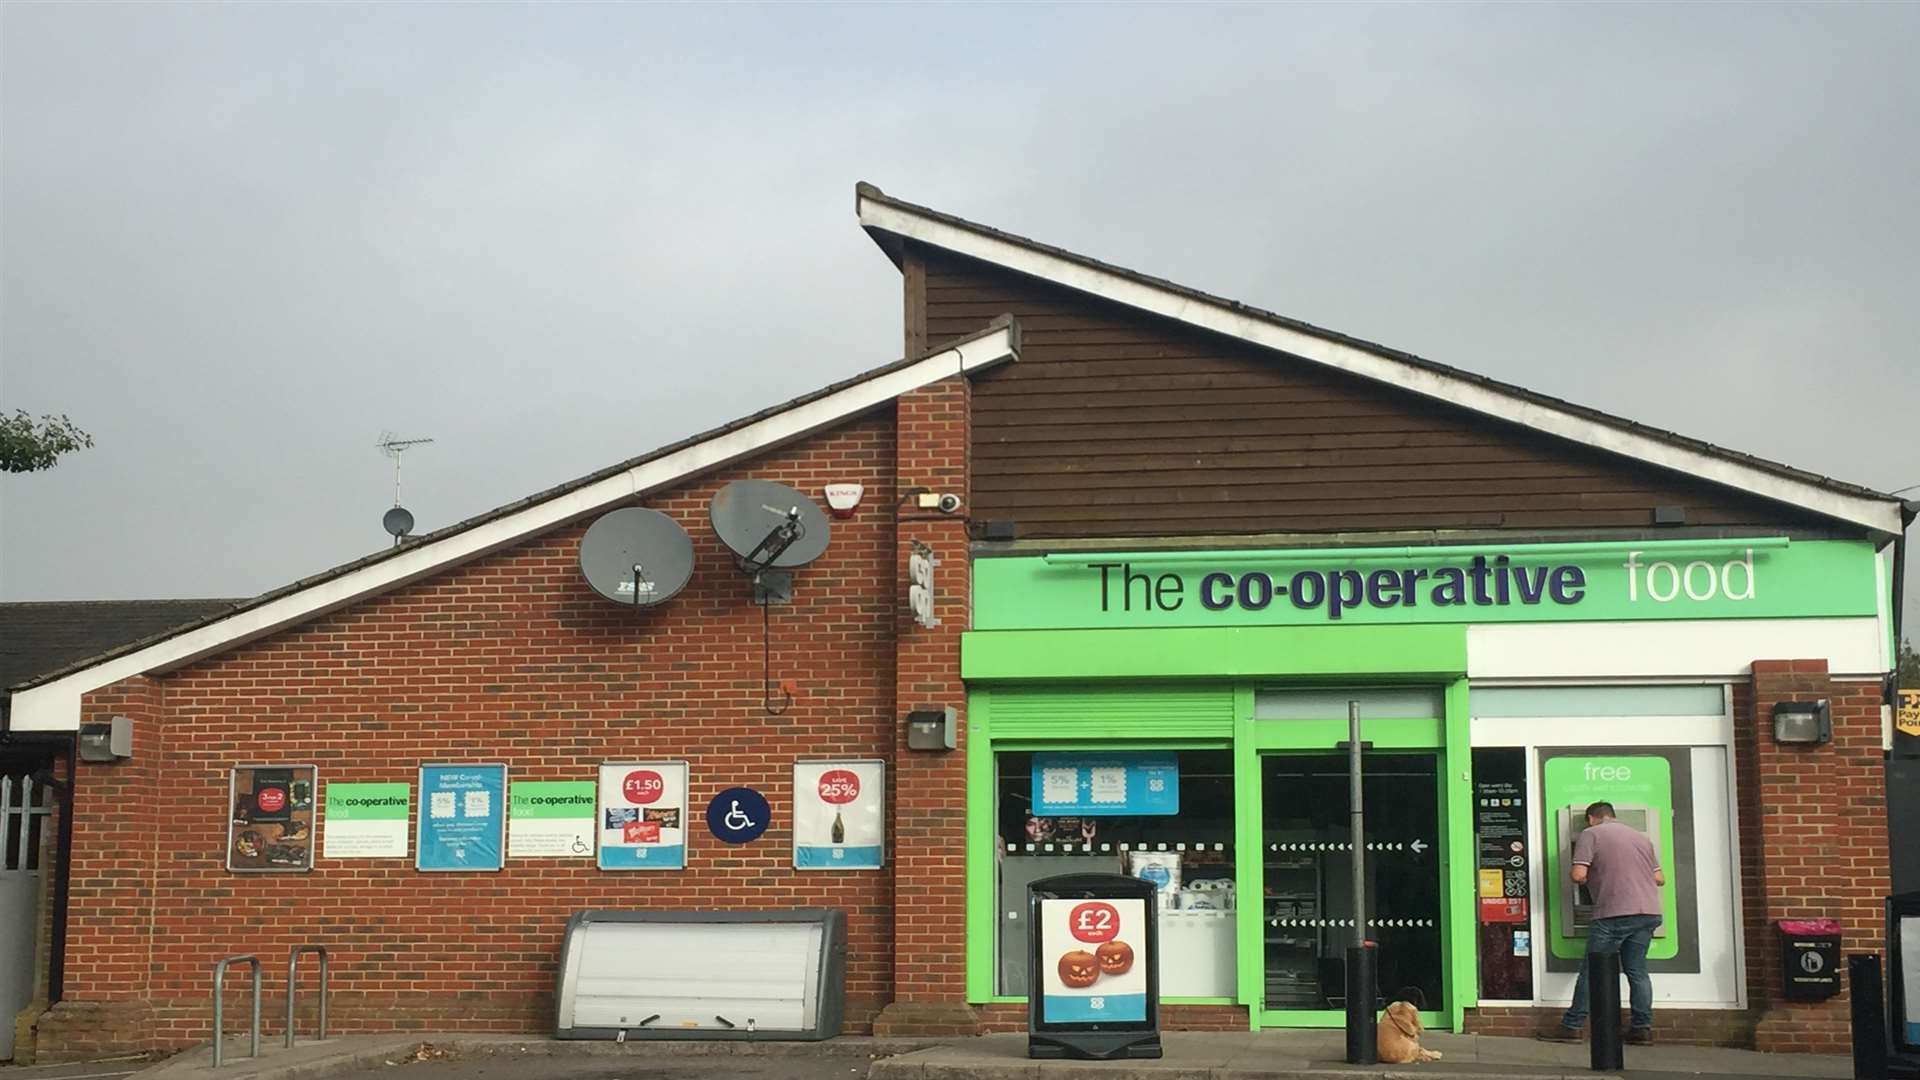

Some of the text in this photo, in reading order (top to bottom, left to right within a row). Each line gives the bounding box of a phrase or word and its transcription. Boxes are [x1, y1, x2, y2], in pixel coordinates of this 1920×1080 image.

[1087, 548, 1756, 620] The co-operative food
[1898, 710, 1920, 720] Pay
[1583, 761, 1632, 781] free
[624, 778, 662, 791] £1.50
[1050, 775, 1071, 785] 5%
[820, 783, 858, 797] 25%
[328, 796, 408, 808] The co-operative
[513, 795, 594, 807] The co-operative
[1077, 909, 1112, 930] £2
